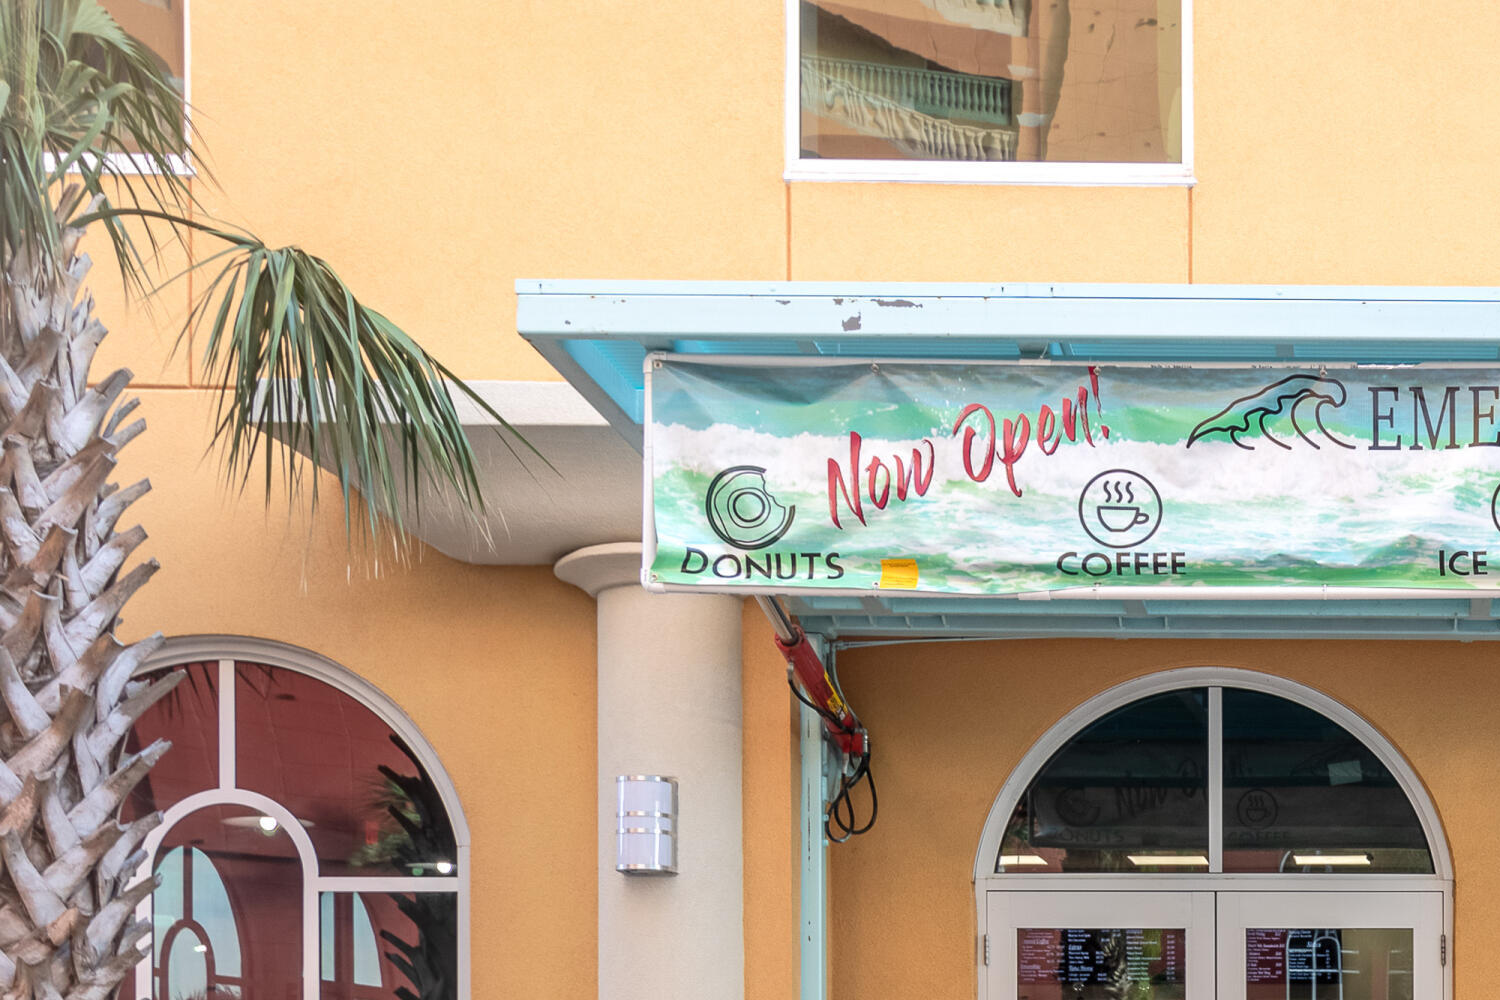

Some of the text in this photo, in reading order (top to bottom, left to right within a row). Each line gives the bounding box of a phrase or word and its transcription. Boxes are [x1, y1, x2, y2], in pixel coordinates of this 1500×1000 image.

[827, 431, 935, 530] Now
[680, 546, 844, 580] DONUTS
[1056, 551, 1187, 577] COFFEE
[1439, 550, 1488, 577] ICE
